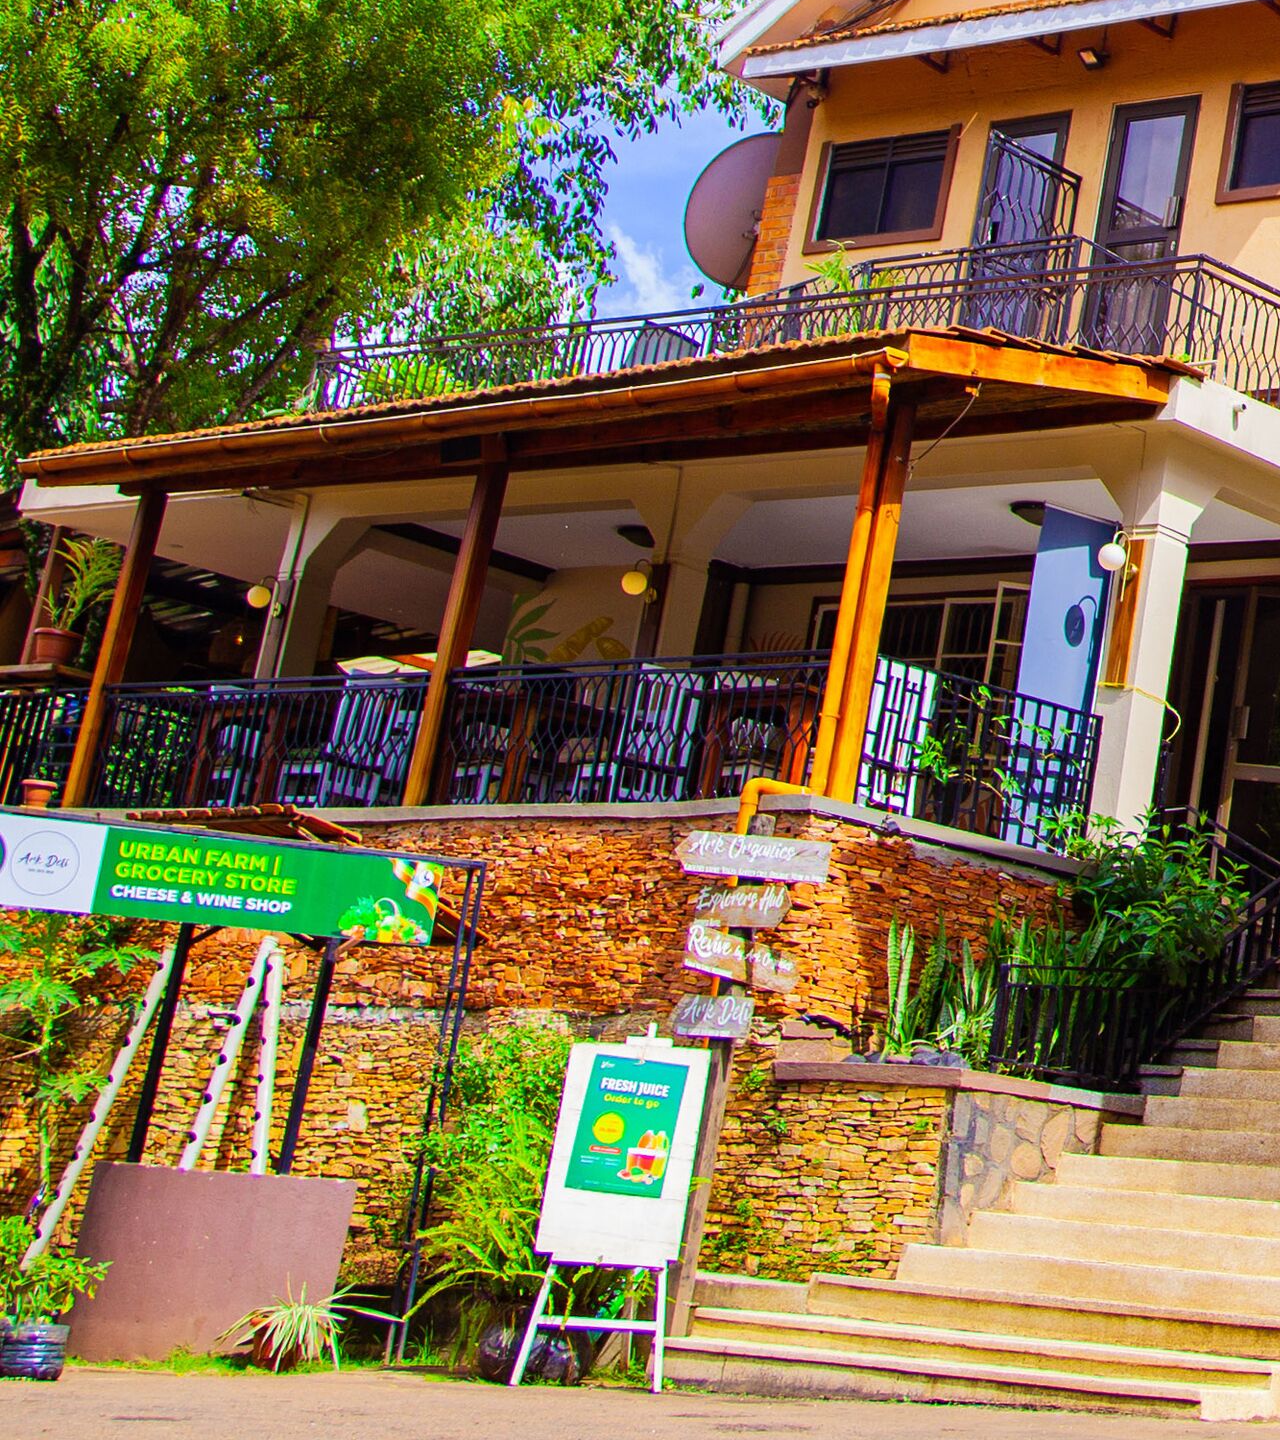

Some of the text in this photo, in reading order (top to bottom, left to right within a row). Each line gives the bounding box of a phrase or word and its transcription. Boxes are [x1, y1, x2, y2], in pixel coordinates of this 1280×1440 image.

[119, 840, 201, 865] URBAN
[204, 848, 269, 873] FARM
[115, 861, 298, 895] GROCERY STORE
[110, 884, 292, 914] CHEESE & WINE SHOP
[600, 1077, 671, 1098] FRESH JUICE
[603, 1093, 661, 1110] Order to go
